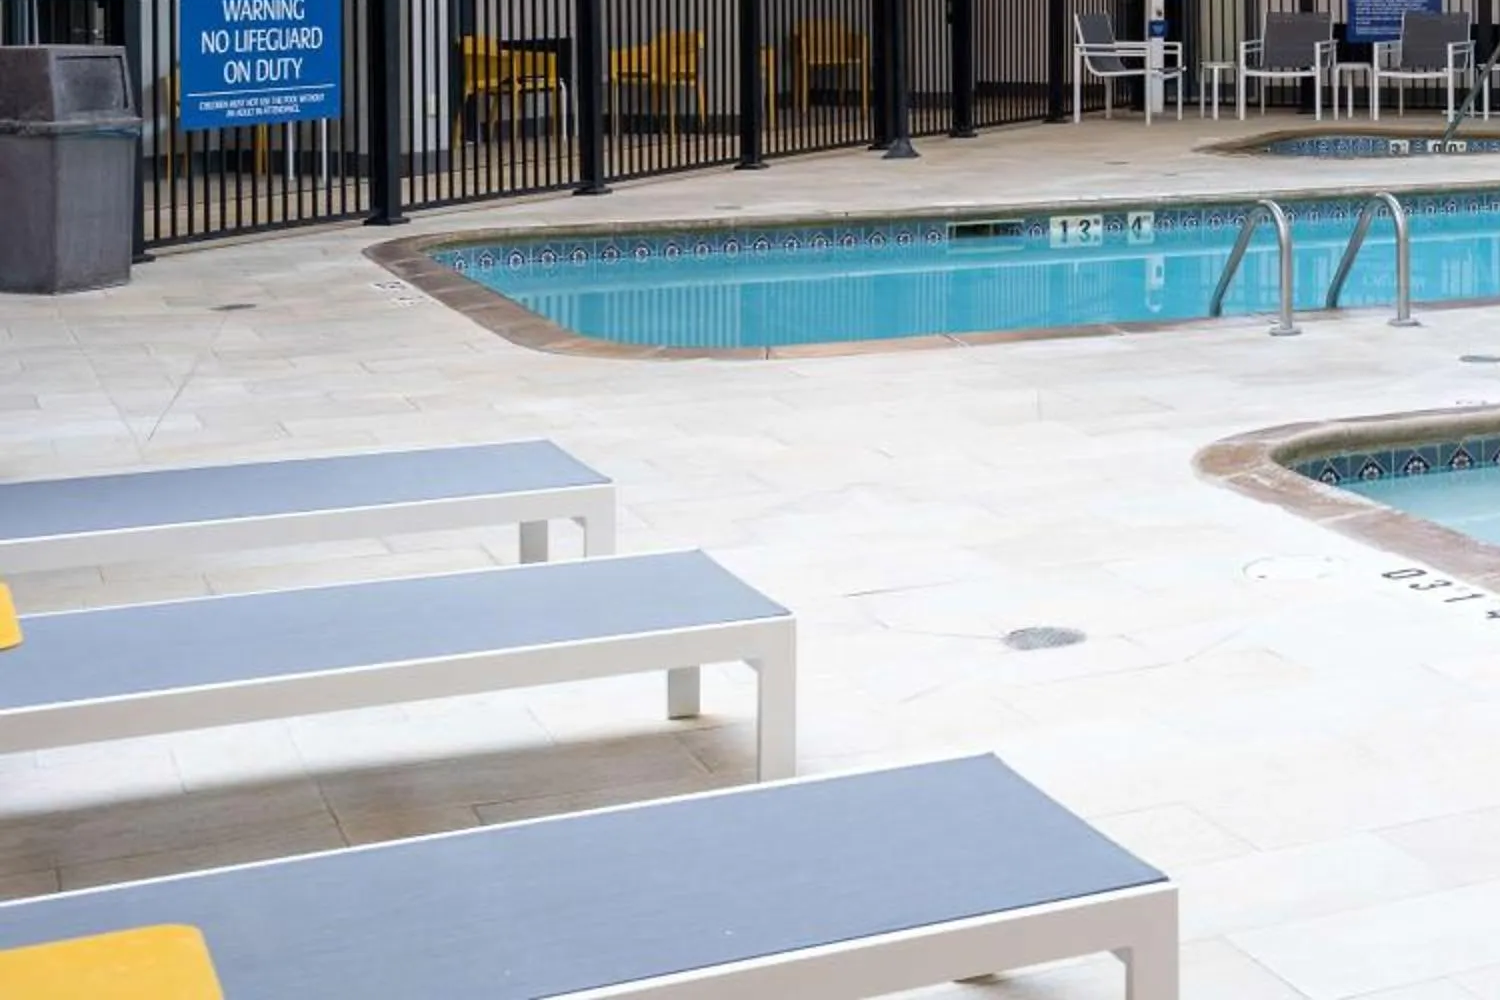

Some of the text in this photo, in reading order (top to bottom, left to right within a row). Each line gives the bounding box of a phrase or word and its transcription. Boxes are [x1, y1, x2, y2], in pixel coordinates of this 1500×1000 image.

[201, 26, 323, 55] NO LIFEGUARD
[223, 57, 303, 84] ON DUTY
